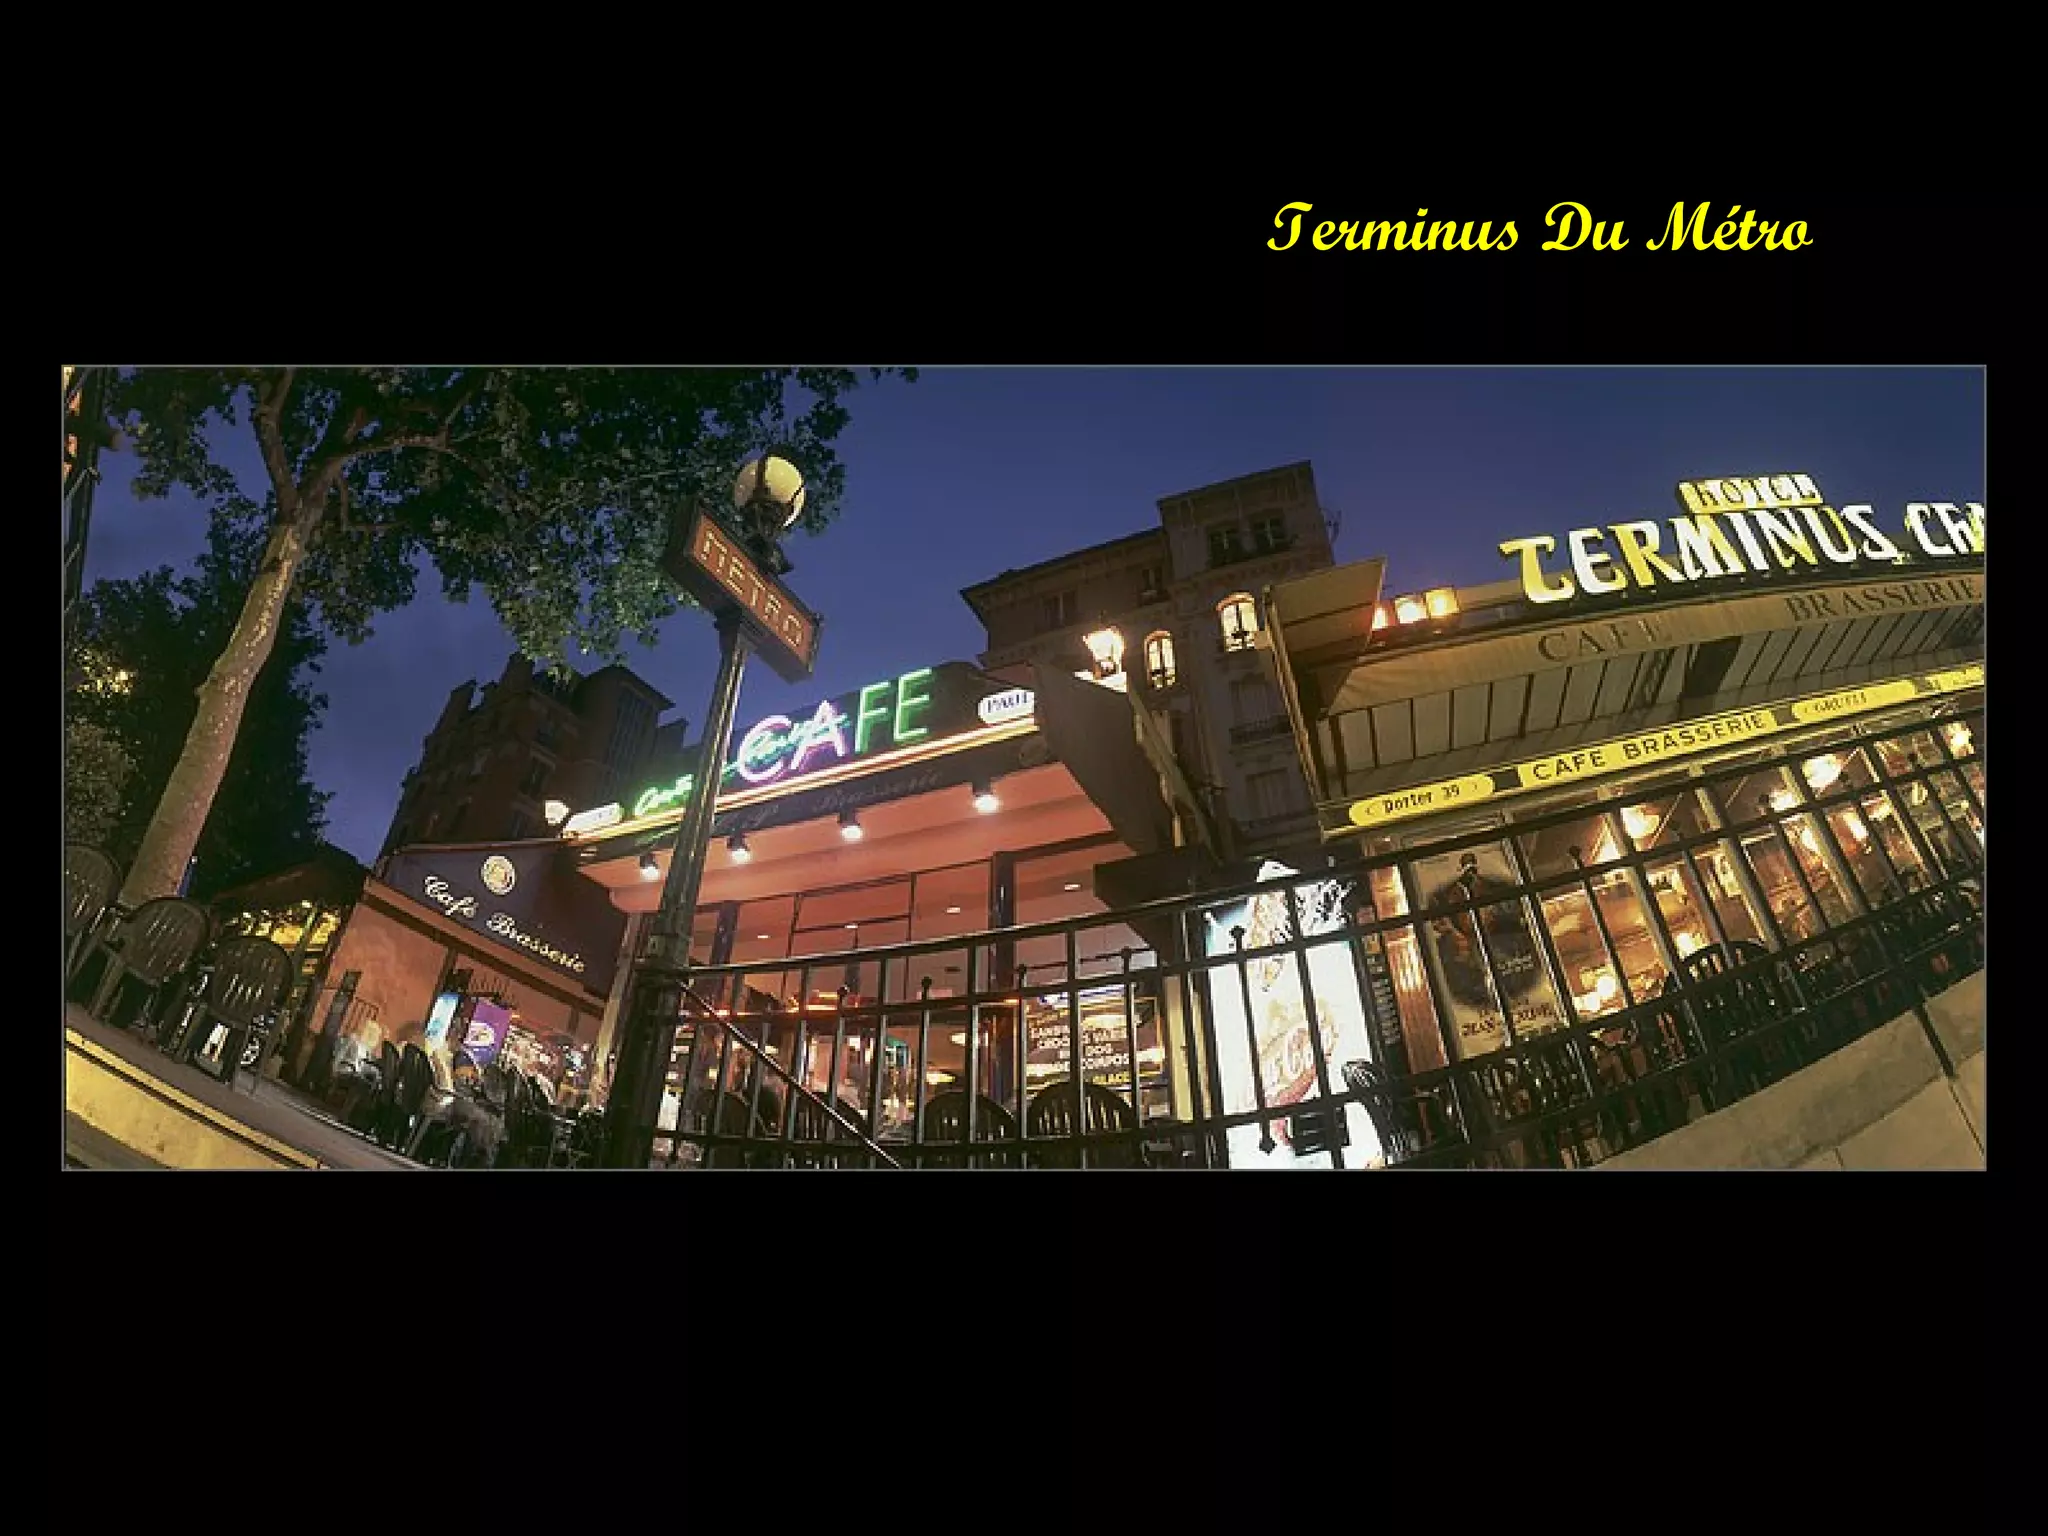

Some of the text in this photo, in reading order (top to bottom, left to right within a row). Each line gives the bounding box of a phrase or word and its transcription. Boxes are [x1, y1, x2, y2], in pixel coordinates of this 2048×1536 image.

[1499, 503, 1904, 604] TERMINUS
[1785, 577, 1983, 622] BRASSERIE
[737, 667, 933, 783] CAFE
[1532, 711, 1768, 782] CAFE BRASSERIE
[485, 911, 586, 973] Brasserie
